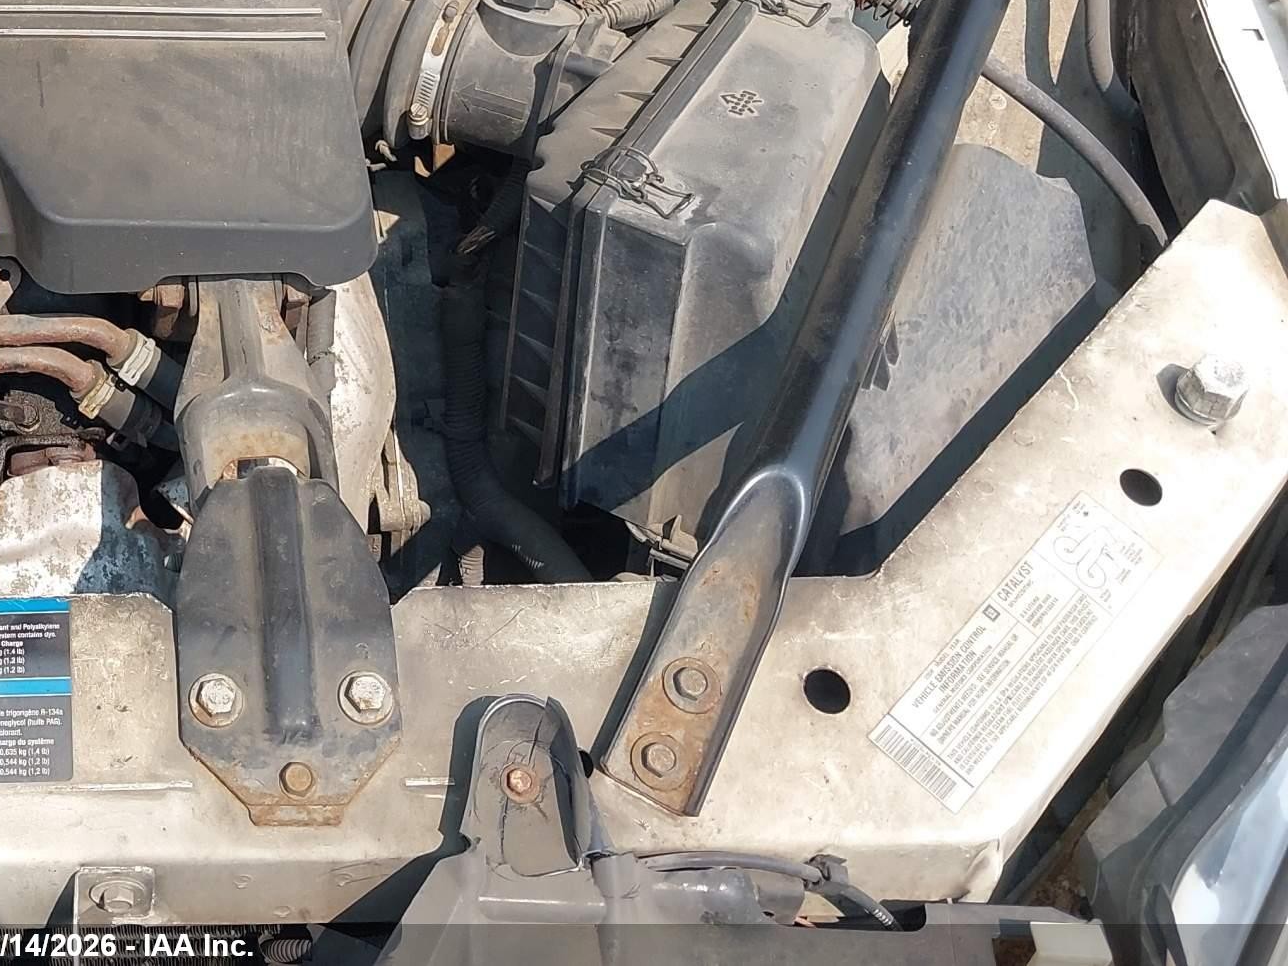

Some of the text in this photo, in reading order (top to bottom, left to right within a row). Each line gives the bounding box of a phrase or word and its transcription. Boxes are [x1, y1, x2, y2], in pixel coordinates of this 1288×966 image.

[995, 560, 1035, 602] CATALYST
[1, 640, 23, 648] Charge
[910, 679, 938, 709] VEHICLE
[933, 650, 963, 683] EMISSION
[958, 623, 987, 654] CONTROL
[937, 649, 977, 693] INFORMATION
